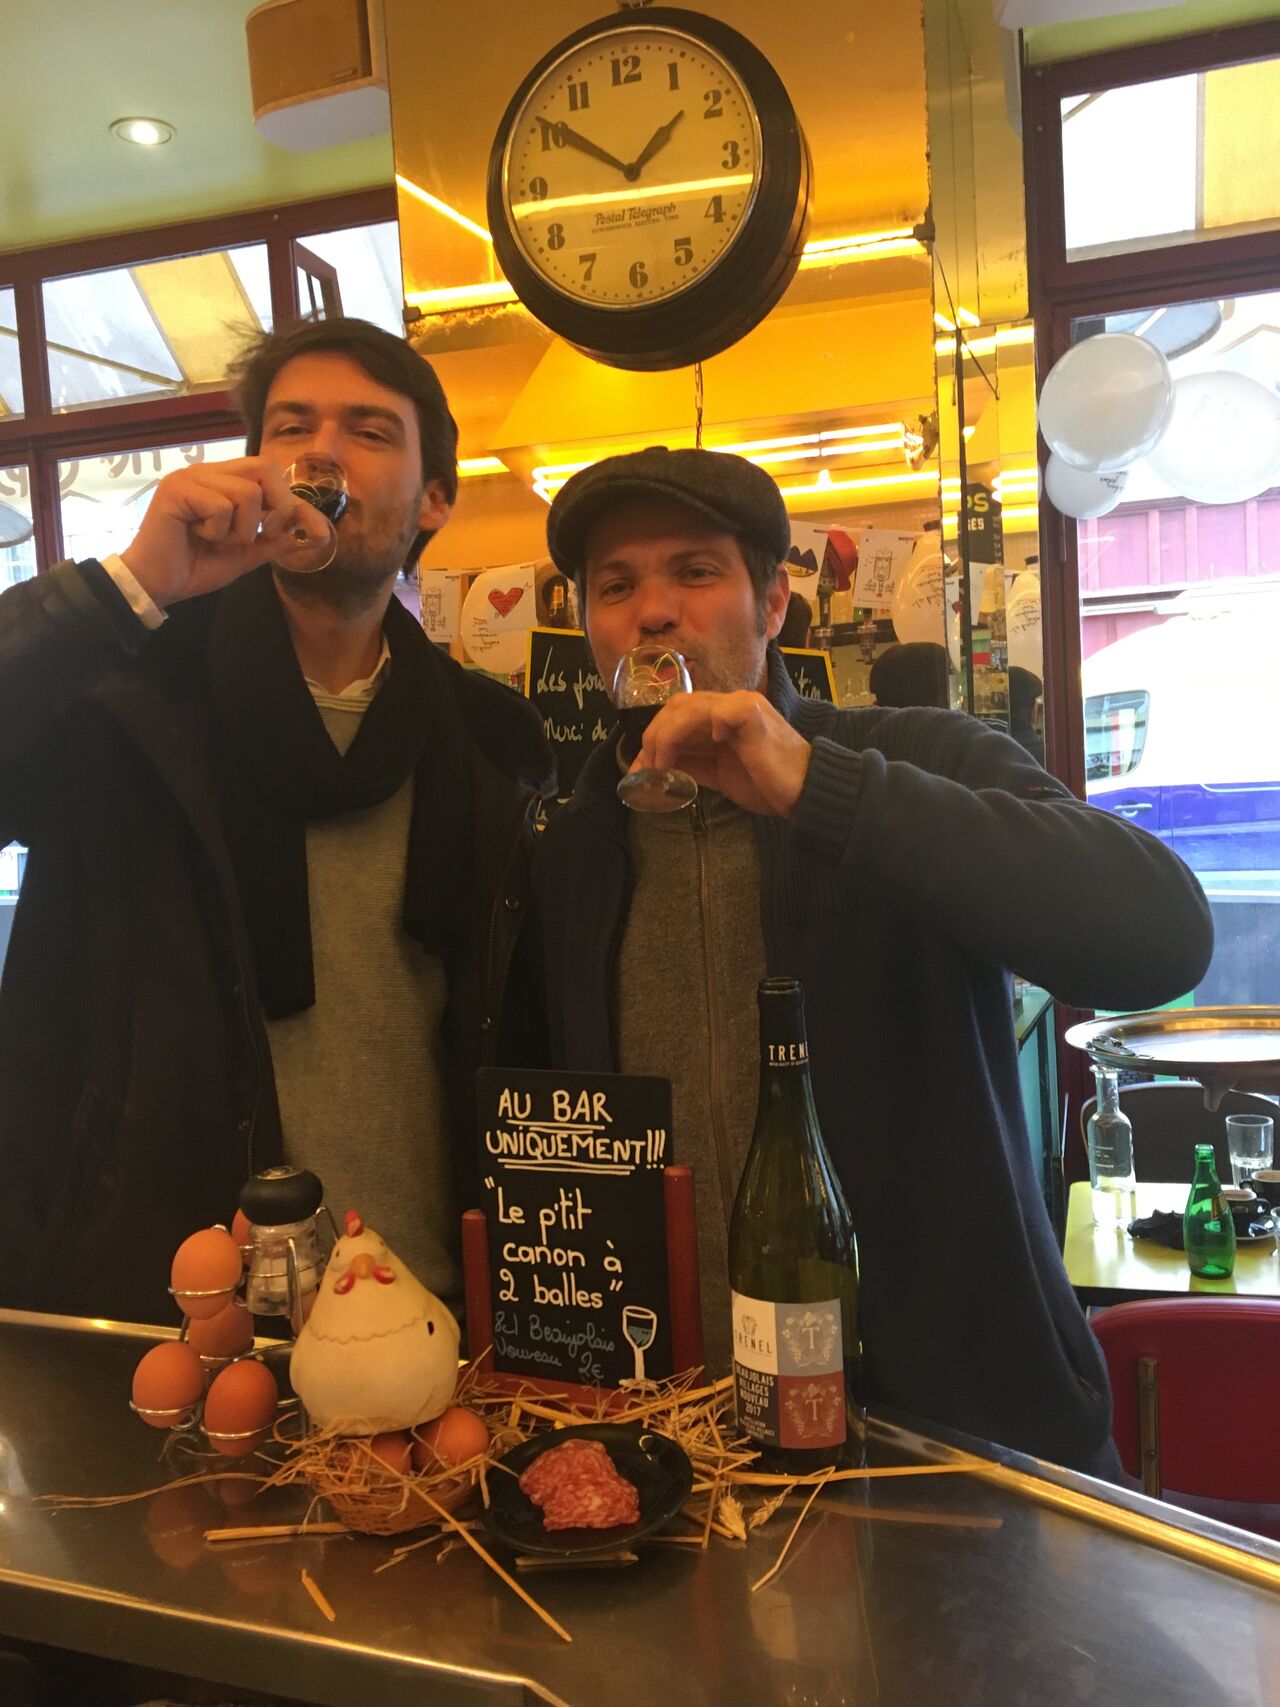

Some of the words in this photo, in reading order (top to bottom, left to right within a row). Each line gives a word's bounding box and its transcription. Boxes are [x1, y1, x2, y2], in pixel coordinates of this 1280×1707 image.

[610, 55, 642, 86] 12
[667, 61, 680, 91] 1
[568, 81, 590, 112] 11
[703, 89, 725, 120] 2
[540, 121, 569, 151] 10
[721, 140, 741, 170] 3
[529, 176, 549, 201] 9
[594, 209, 626, 226] Postal
[627, 202, 677, 221] Telegraph
[704, 194, 727, 224] 4
[547, 223, 566, 250] 8
[673, 237, 694, 266] 5
[579, 253, 597, 281] 7
[628, 260, 649, 289] 6
[768, 1041, 809, 1061] TREN
[498, 1087, 531, 1118] AU
[552, 1089, 613, 1123] BAR
[539, 1187, 592, 1245] p'tit
[503, 1242, 586, 1267] canon
[603, 1239, 622, 1273] à
[499, 1268, 519, 1301] 2
[578, 1351, 604, 1379] 2€
